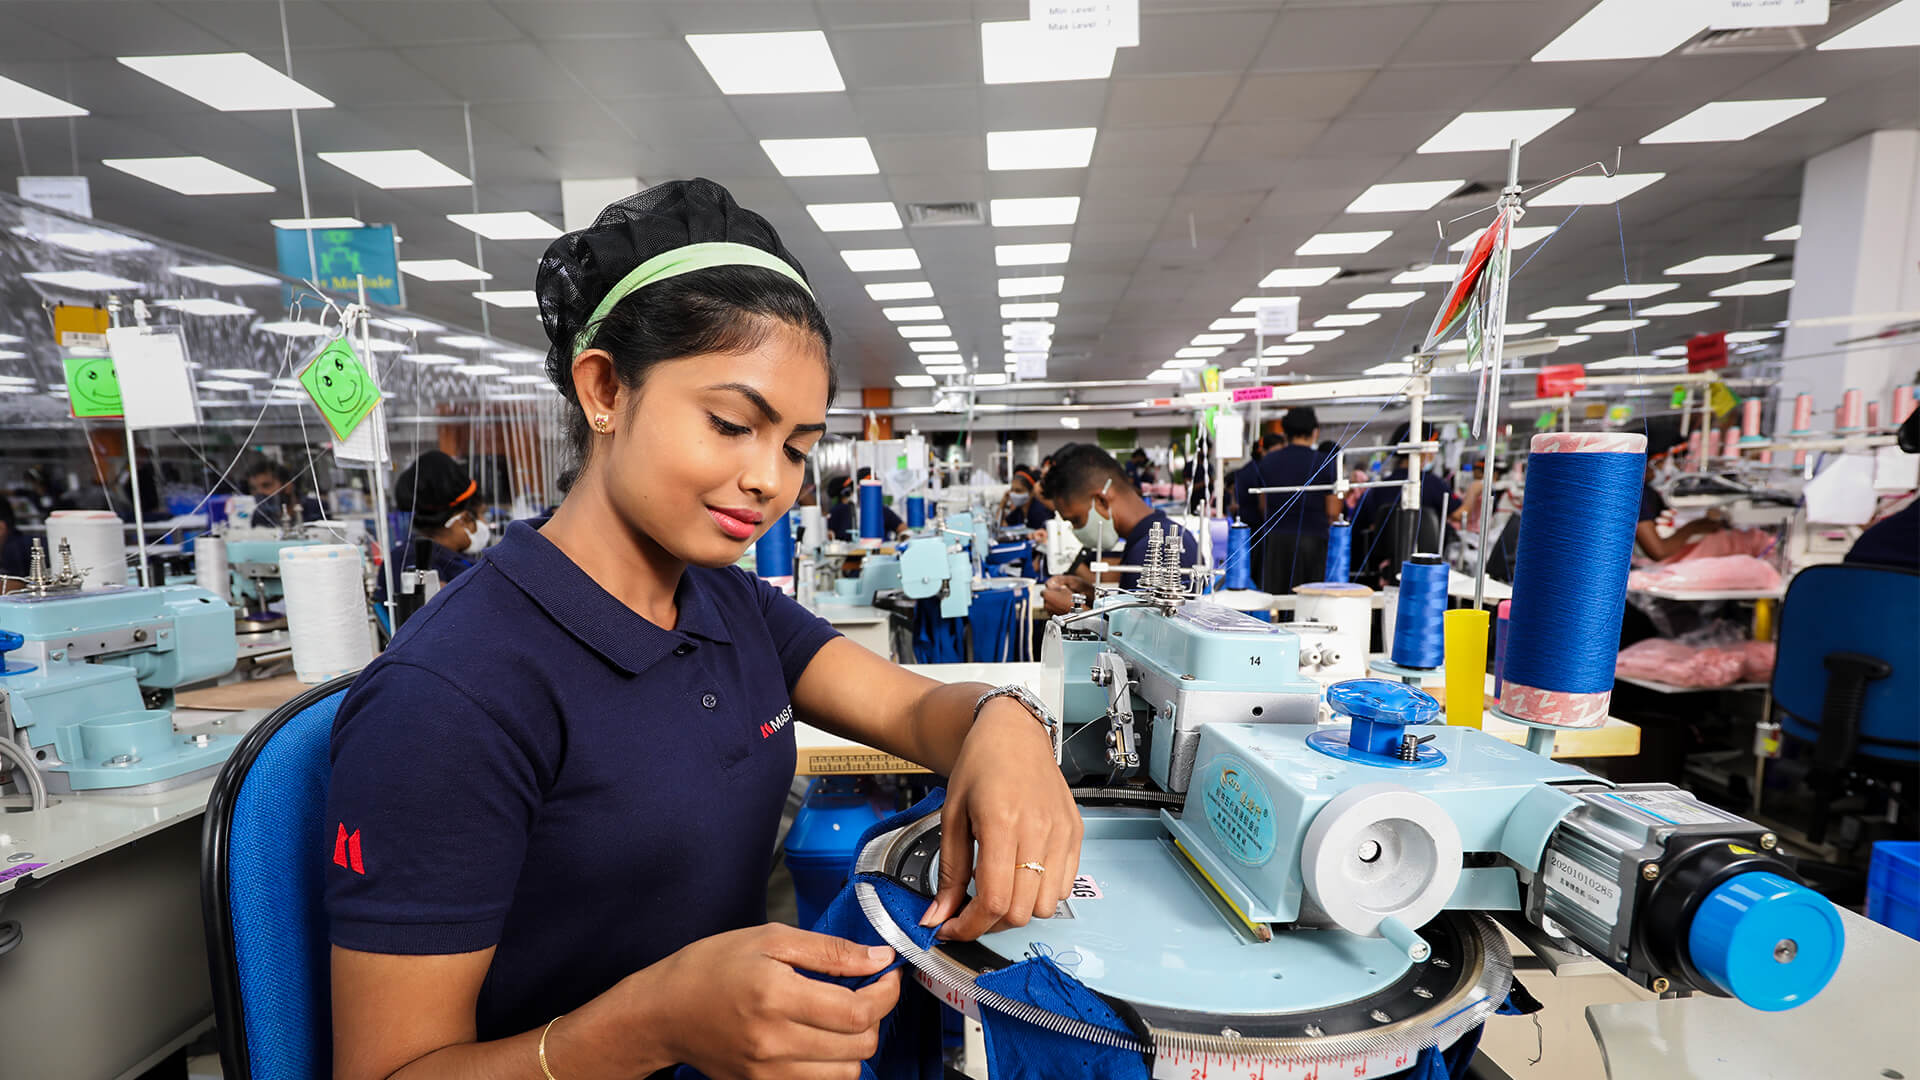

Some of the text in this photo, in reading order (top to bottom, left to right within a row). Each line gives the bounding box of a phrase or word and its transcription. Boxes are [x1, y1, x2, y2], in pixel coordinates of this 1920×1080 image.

[1250, 656, 1261, 666] 14
[770, 709, 790, 732] MAS
[1551, 856, 1614, 899] 20201010285
